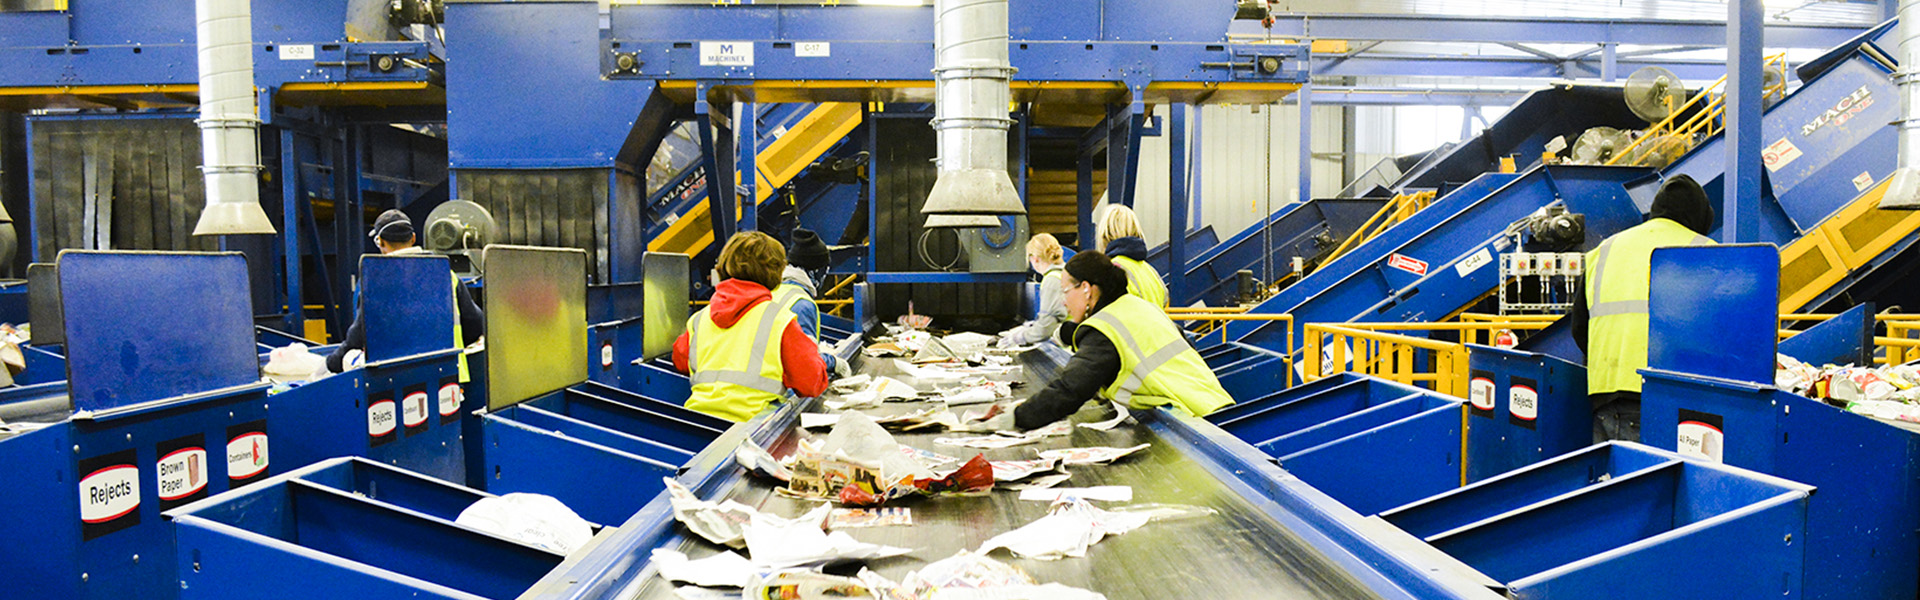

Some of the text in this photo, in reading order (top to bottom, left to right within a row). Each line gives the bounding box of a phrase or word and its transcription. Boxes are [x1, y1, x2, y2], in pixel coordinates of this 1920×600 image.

[288, 46, 305, 54] C-32
[804, 43, 820, 52] C-17
[707, 55, 746, 63] MACHINEX
[1800, 84, 1872, 137] MACH
[1834, 95, 1875, 126] ONE
[659, 166, 706, 206] MACH
[1465, 254, 1481, 268] C-44
[1514, 393, 1533, 409] Rejects
[372, 410, 392, 426] Rejects
[1686, 435, 1700, 447] Paper
[229, 451, 252, 463] Containers
[160, 461, 185, 476] Brown
[90, 480, 131, 505] Rejects
[161, 478, 183, 493] Paper
